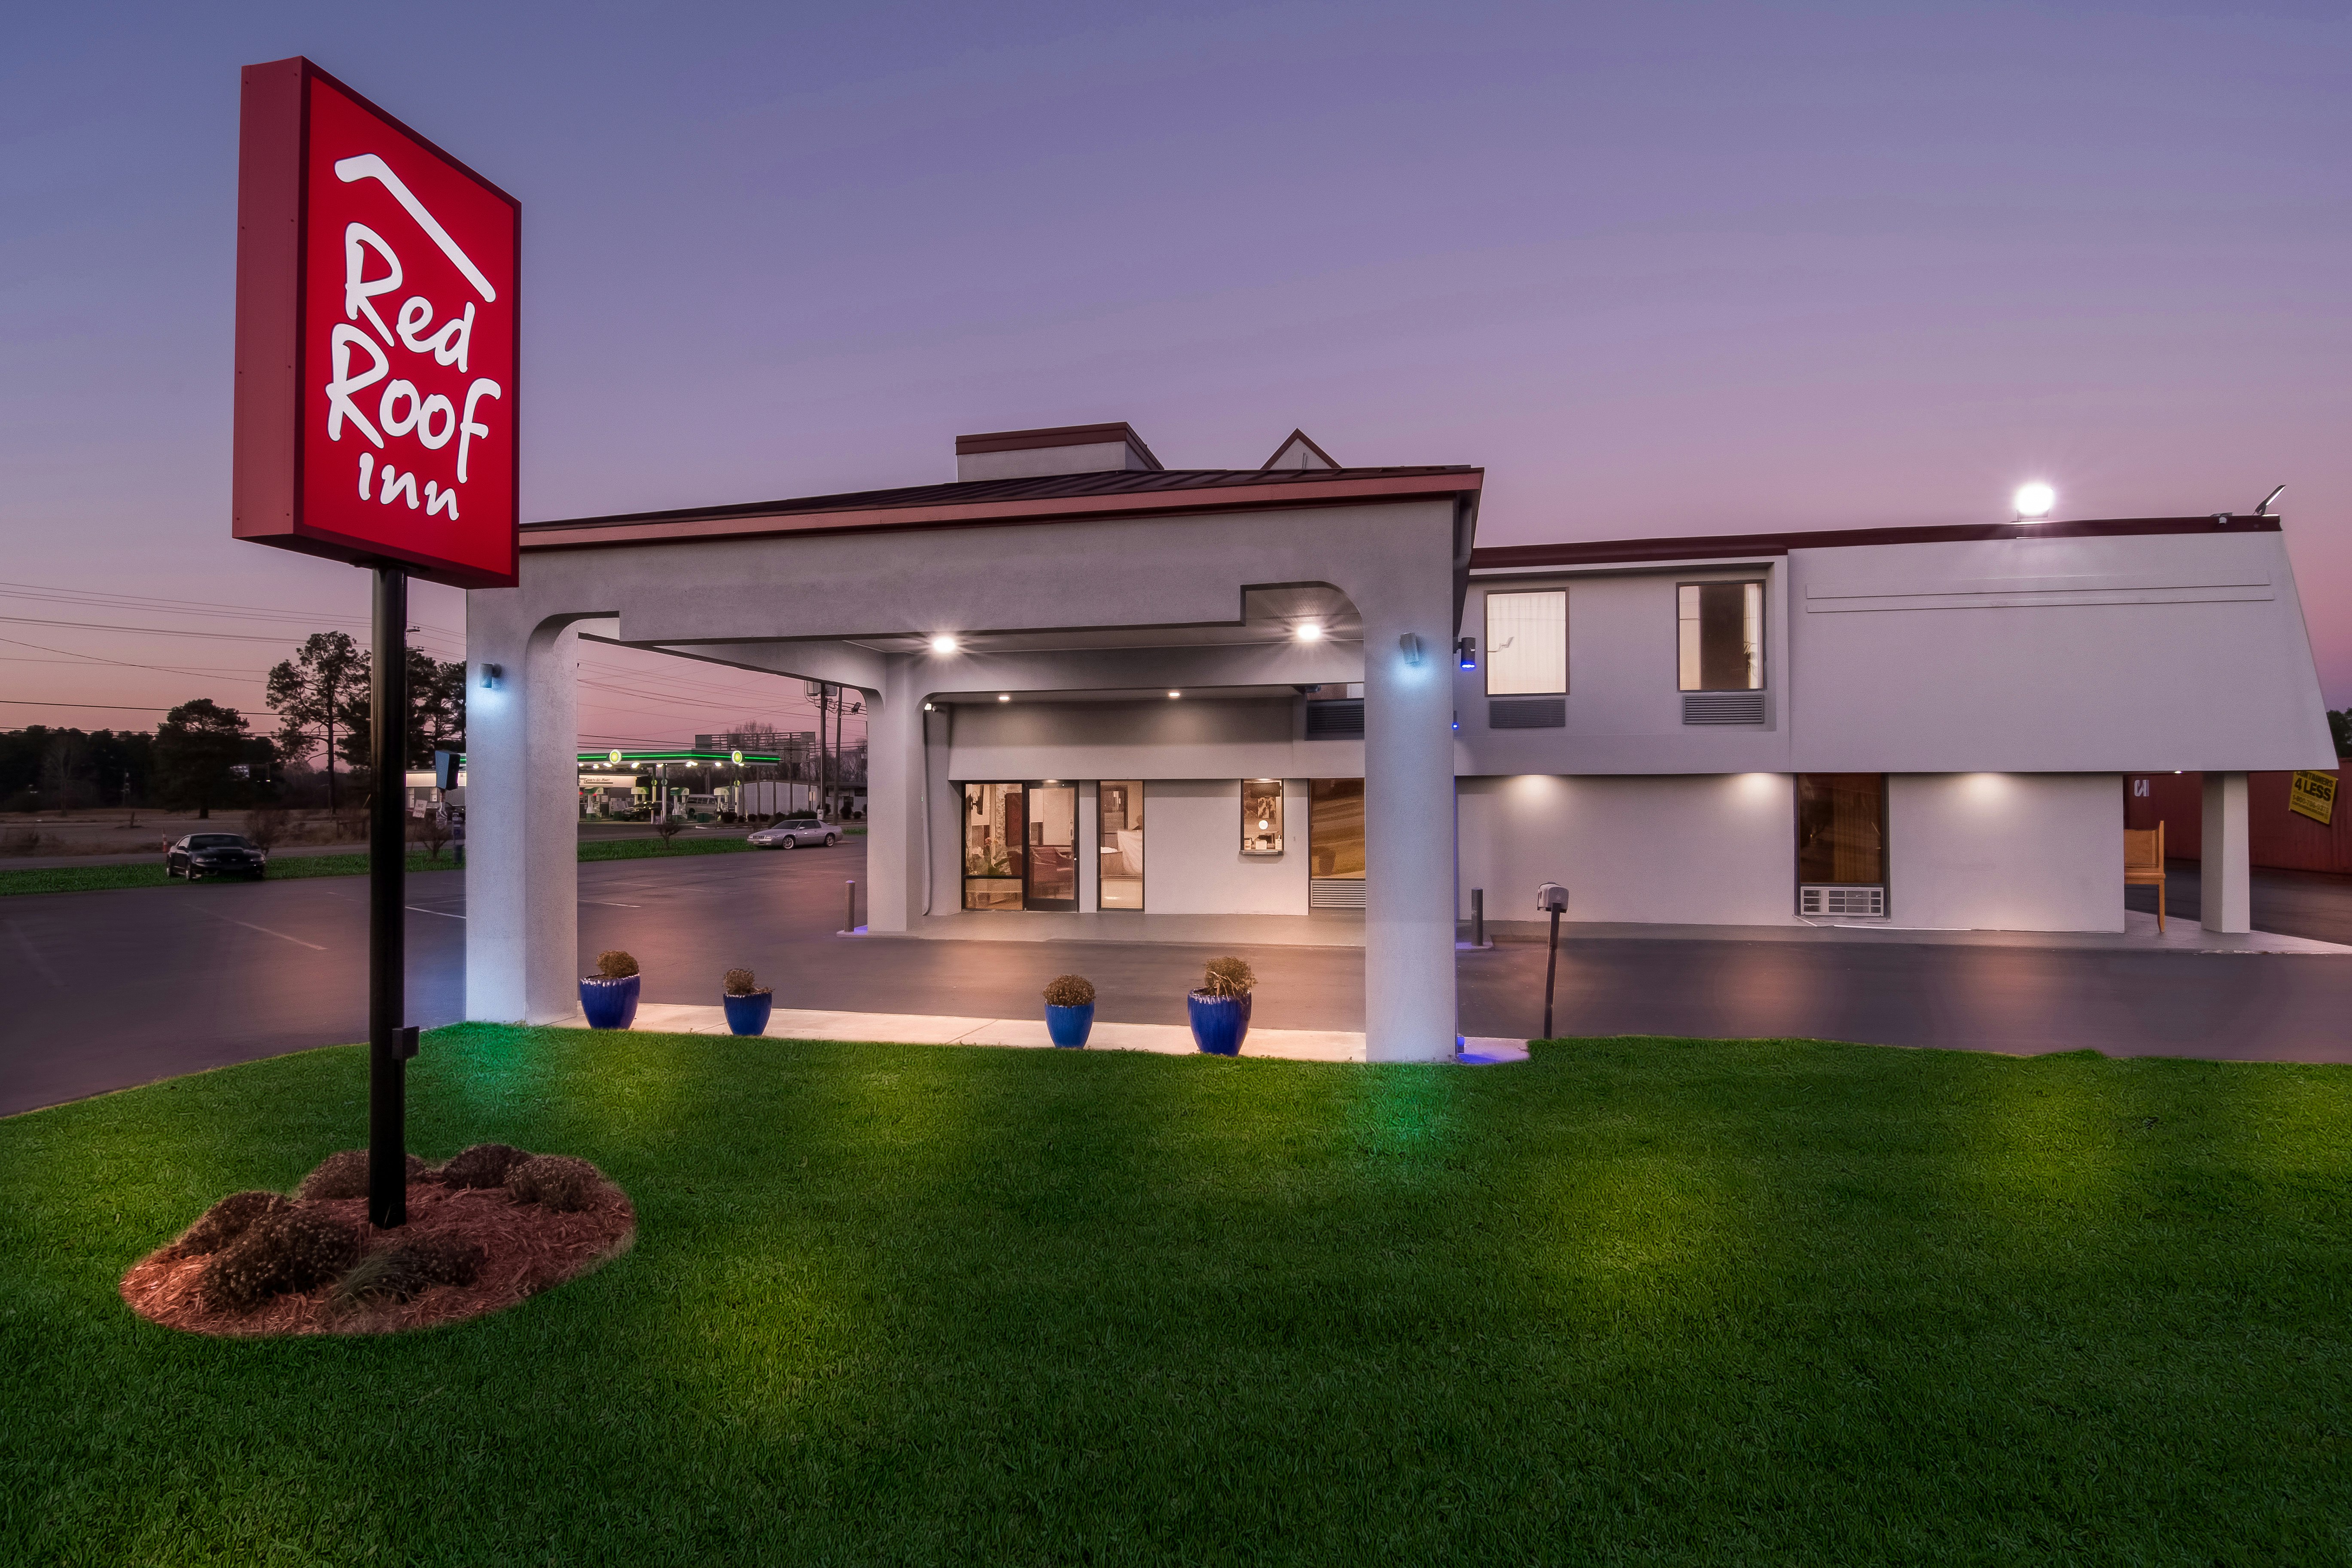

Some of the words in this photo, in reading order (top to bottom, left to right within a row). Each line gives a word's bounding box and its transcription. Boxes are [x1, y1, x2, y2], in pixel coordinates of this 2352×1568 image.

[345, 222, 476, 374] Red
[326, 323, 502, 484] Roof
[2294, 777, 2302, 791] 4
[2303, 779, 2332, 802] LESS
